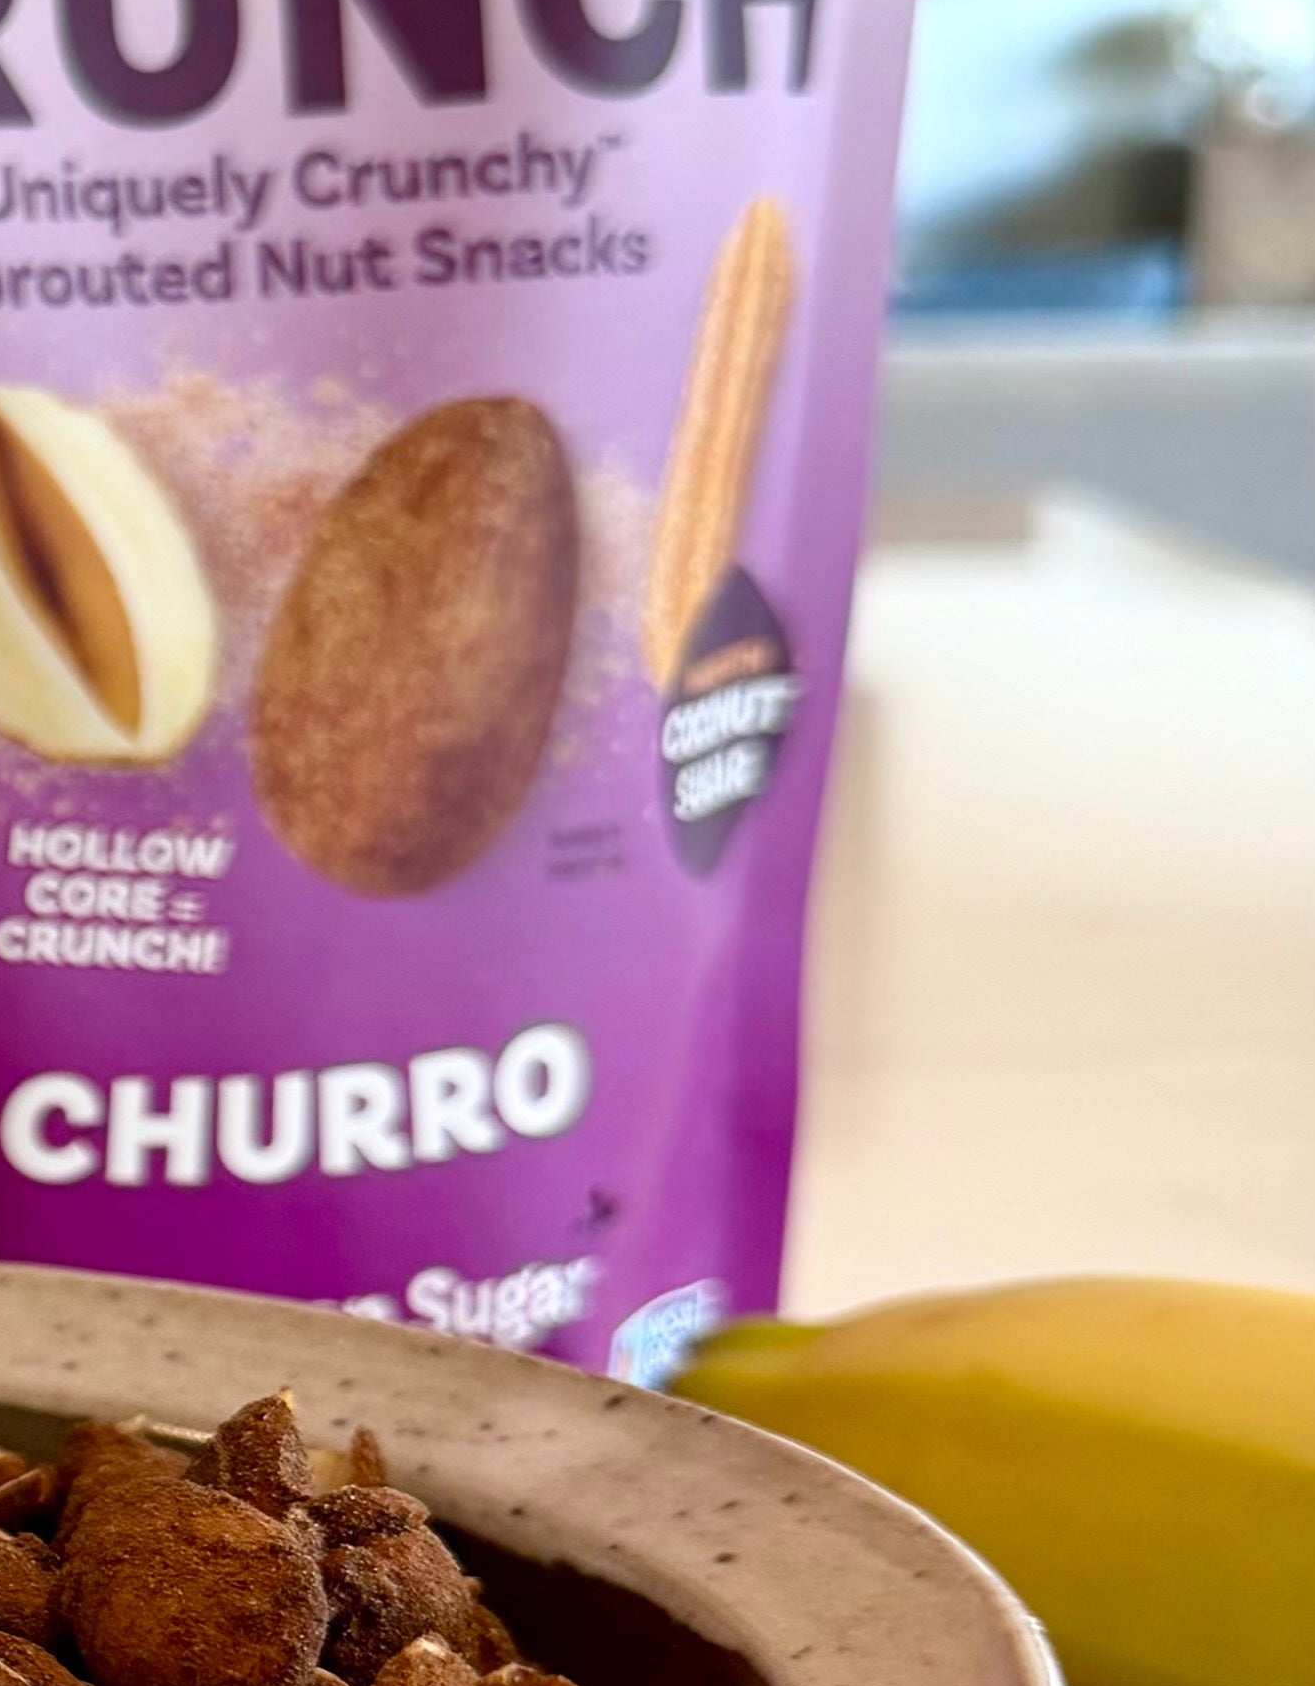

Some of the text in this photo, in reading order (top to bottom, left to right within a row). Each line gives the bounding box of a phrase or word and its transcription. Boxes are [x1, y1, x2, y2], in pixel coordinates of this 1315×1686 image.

[257, 235, 393, 300] Nut
[417, 217, 649, 289] Snacks
[7, 821, 232, 880] HOLLOW
[24, 869, 166, 922] CORE
[0, 1021, 590, 1186] CHURRO
